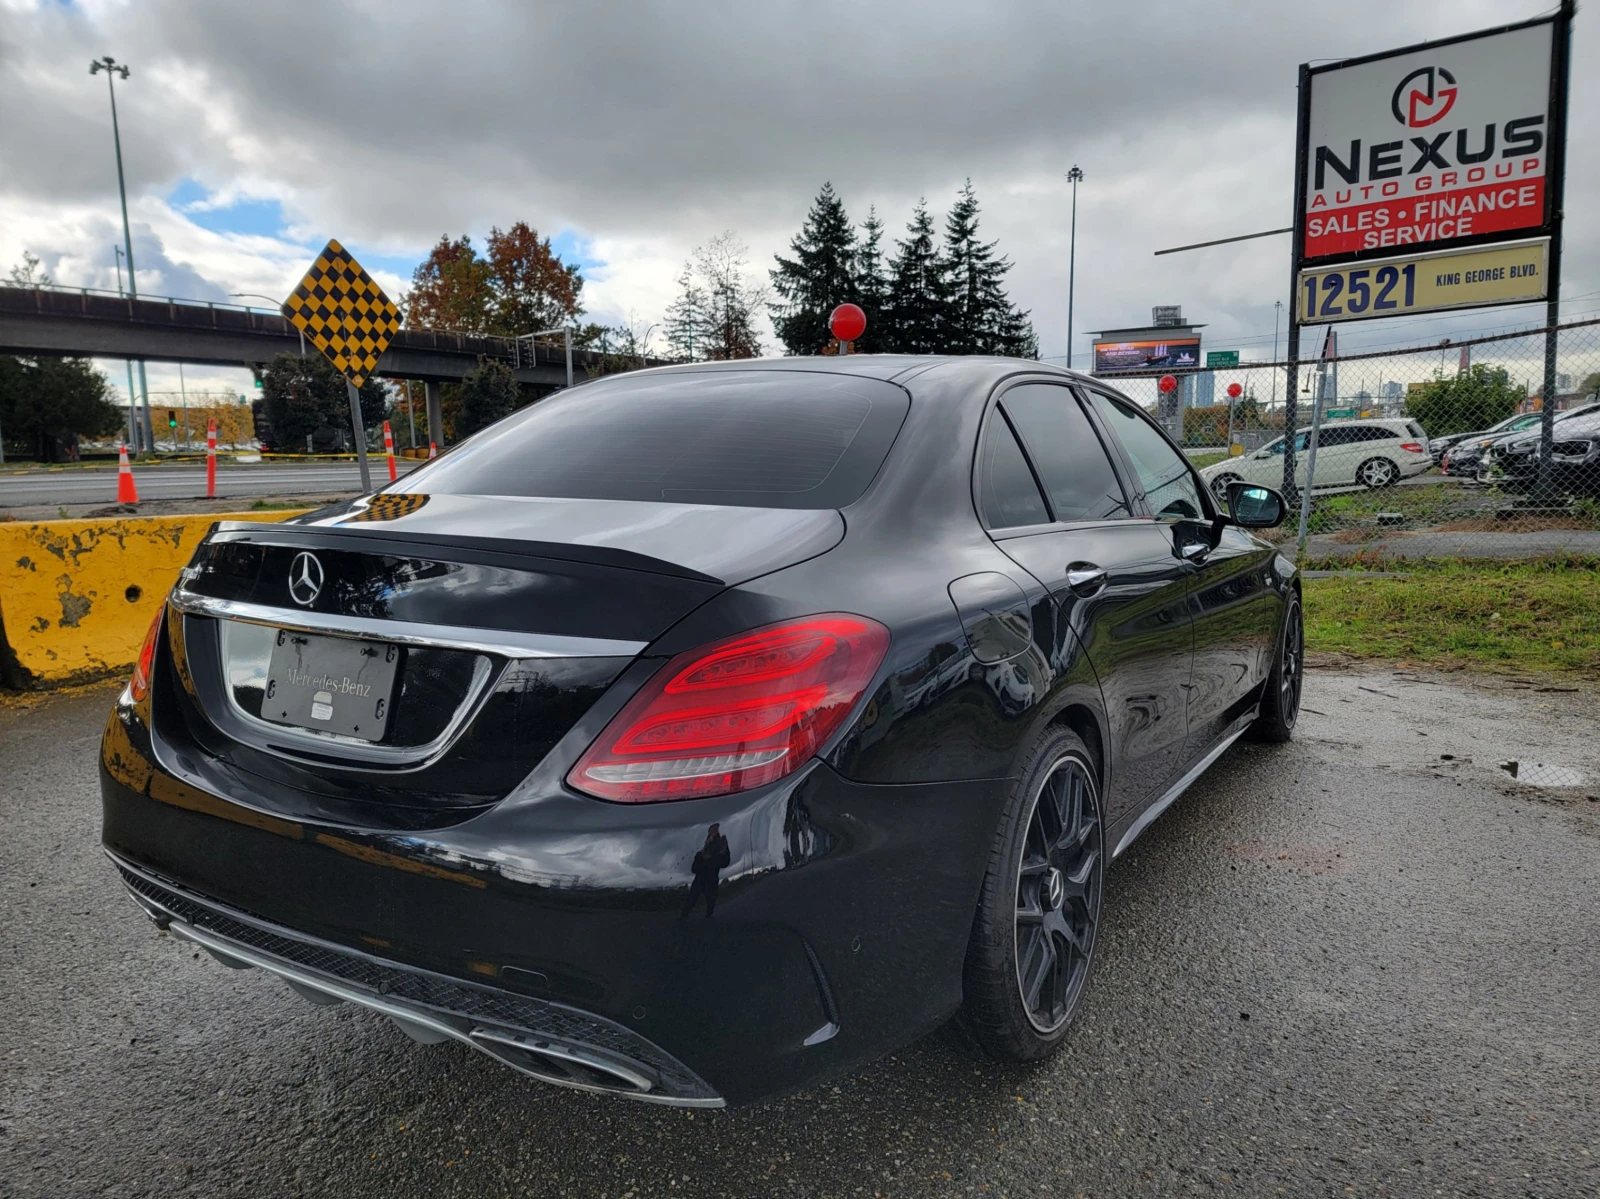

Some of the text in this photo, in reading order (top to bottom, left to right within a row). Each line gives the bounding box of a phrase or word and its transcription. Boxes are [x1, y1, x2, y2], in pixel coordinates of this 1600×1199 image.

[1311, 158, 1540, 208] AUTO GROUP
[1308, 185, 1537, 238] SALES FINANCE
[1363, 217, 1473, 249] SERVICE
[1304, 263, 1539, 318] 12521 KING GEORGE BLVD.
[285, 667, 371, 698] Mercedes-Benz
